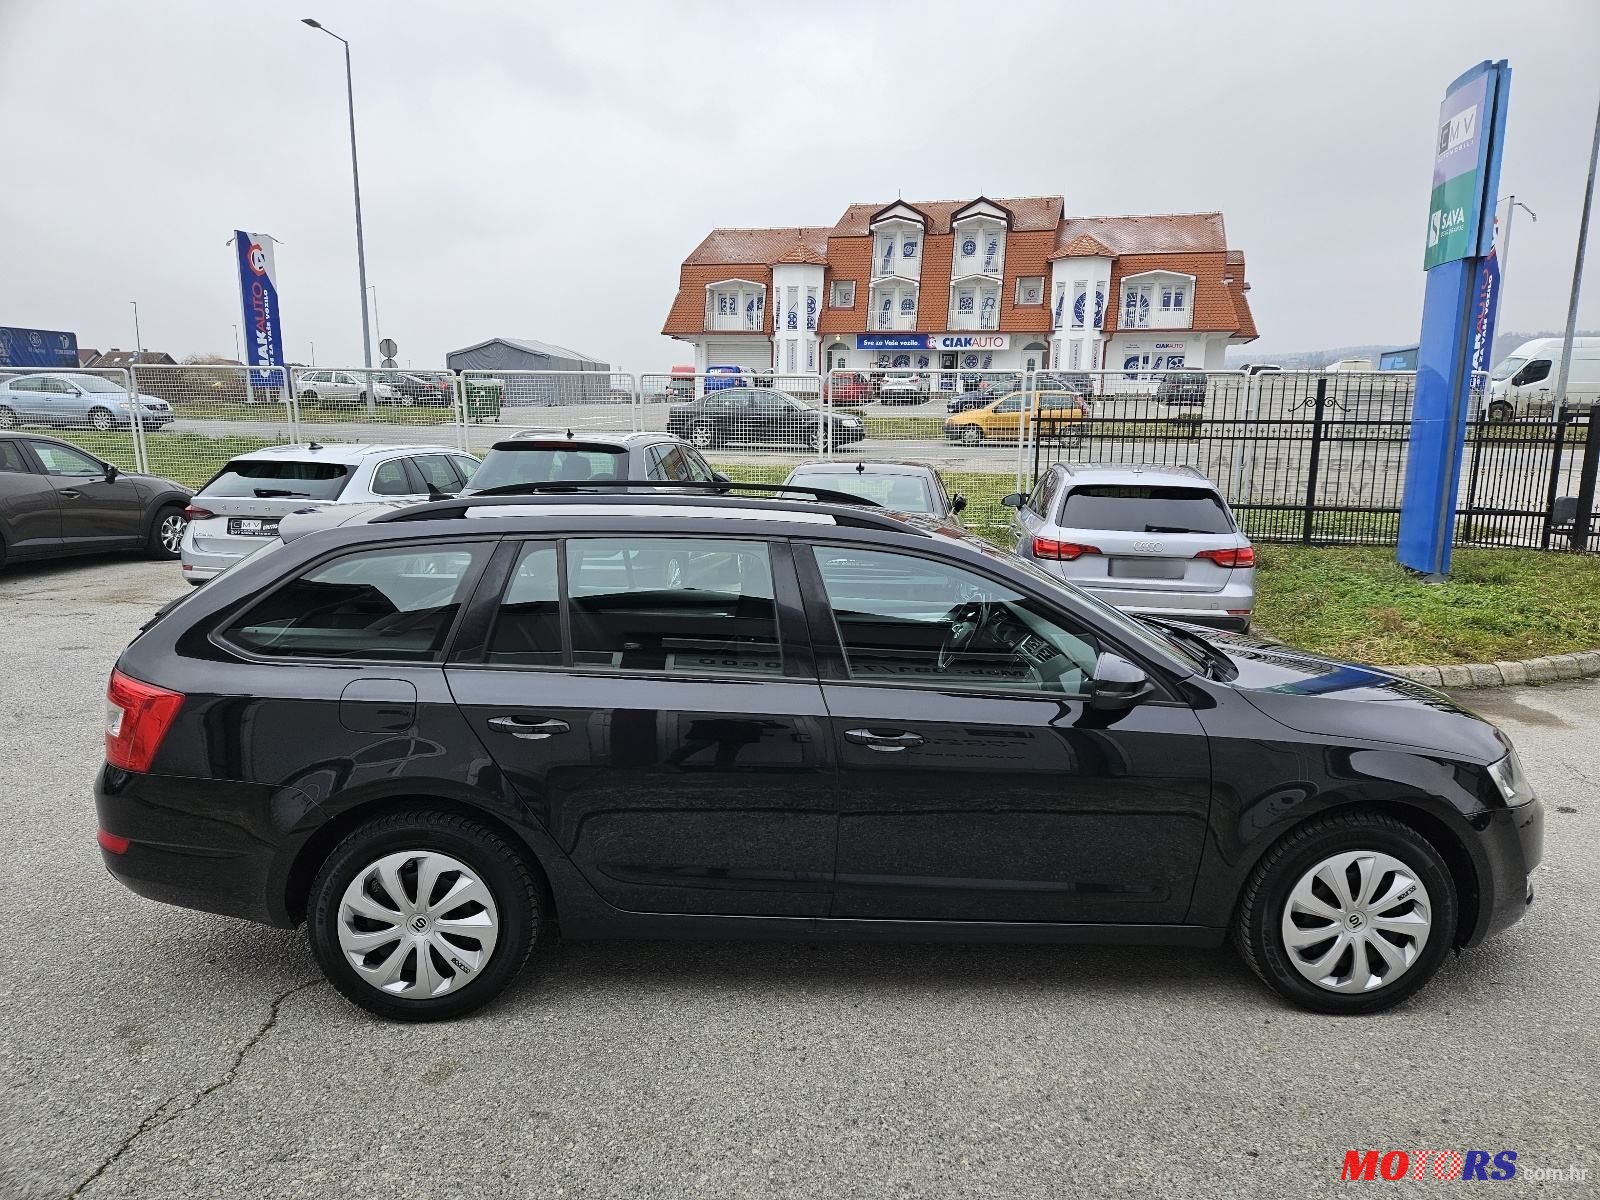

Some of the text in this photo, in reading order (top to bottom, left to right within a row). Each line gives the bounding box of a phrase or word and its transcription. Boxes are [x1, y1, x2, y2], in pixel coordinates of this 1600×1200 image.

[1441, 207, 1465, 230] SAVA
[263, 289, 271, 319] VOZILO
[942, 337, 1004, 348] CIAKAUTO
